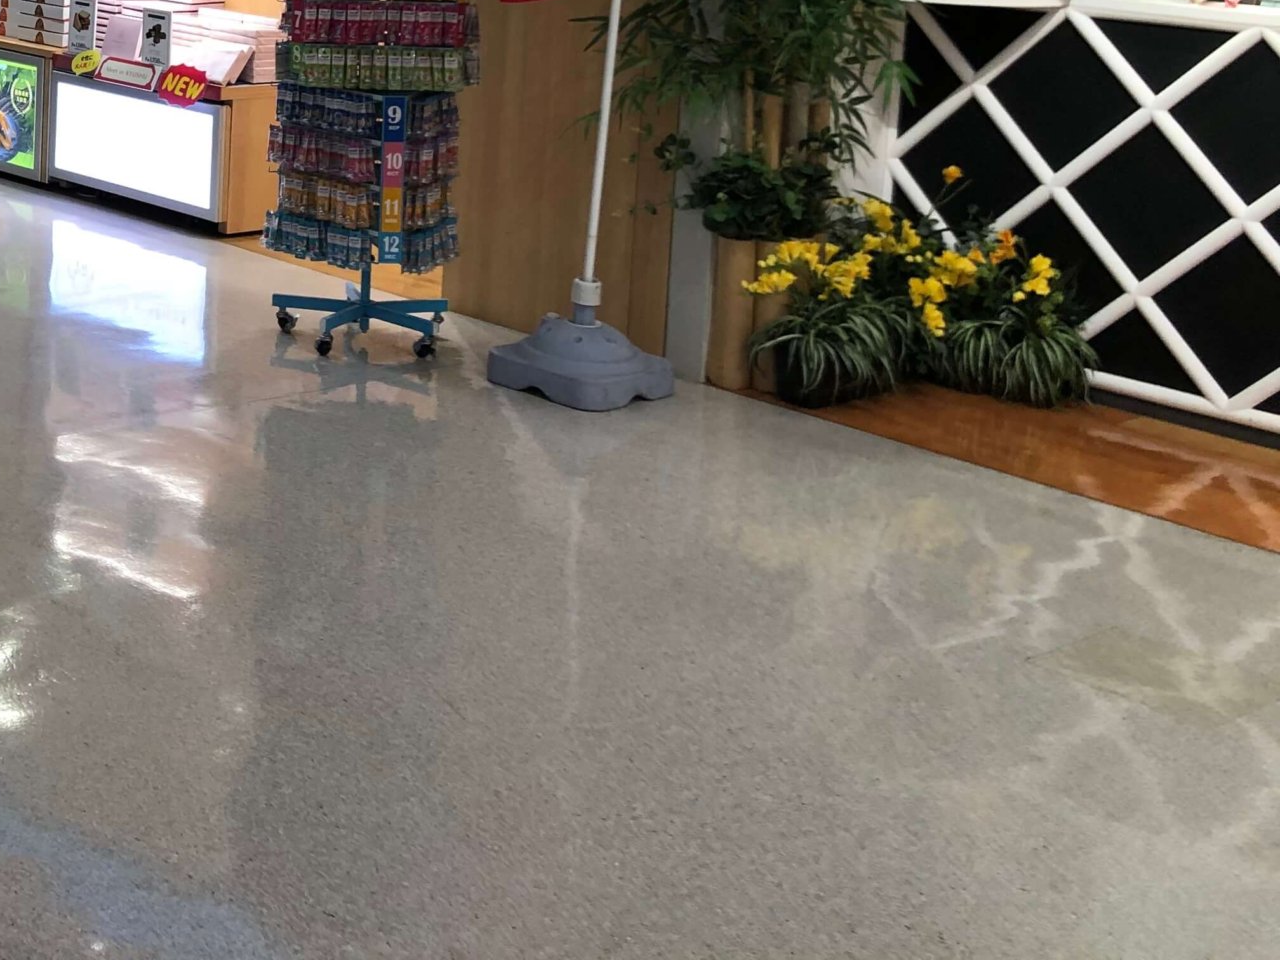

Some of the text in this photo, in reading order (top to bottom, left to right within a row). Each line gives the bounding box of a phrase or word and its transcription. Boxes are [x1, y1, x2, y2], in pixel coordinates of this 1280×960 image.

[161, 72, 206, 100] NEW
[387, 105, 402, 124] 9
[385, 152, 403, 170] 10
[384, 199, 399, 216] 11
[383, 235, 400, 253] 12
